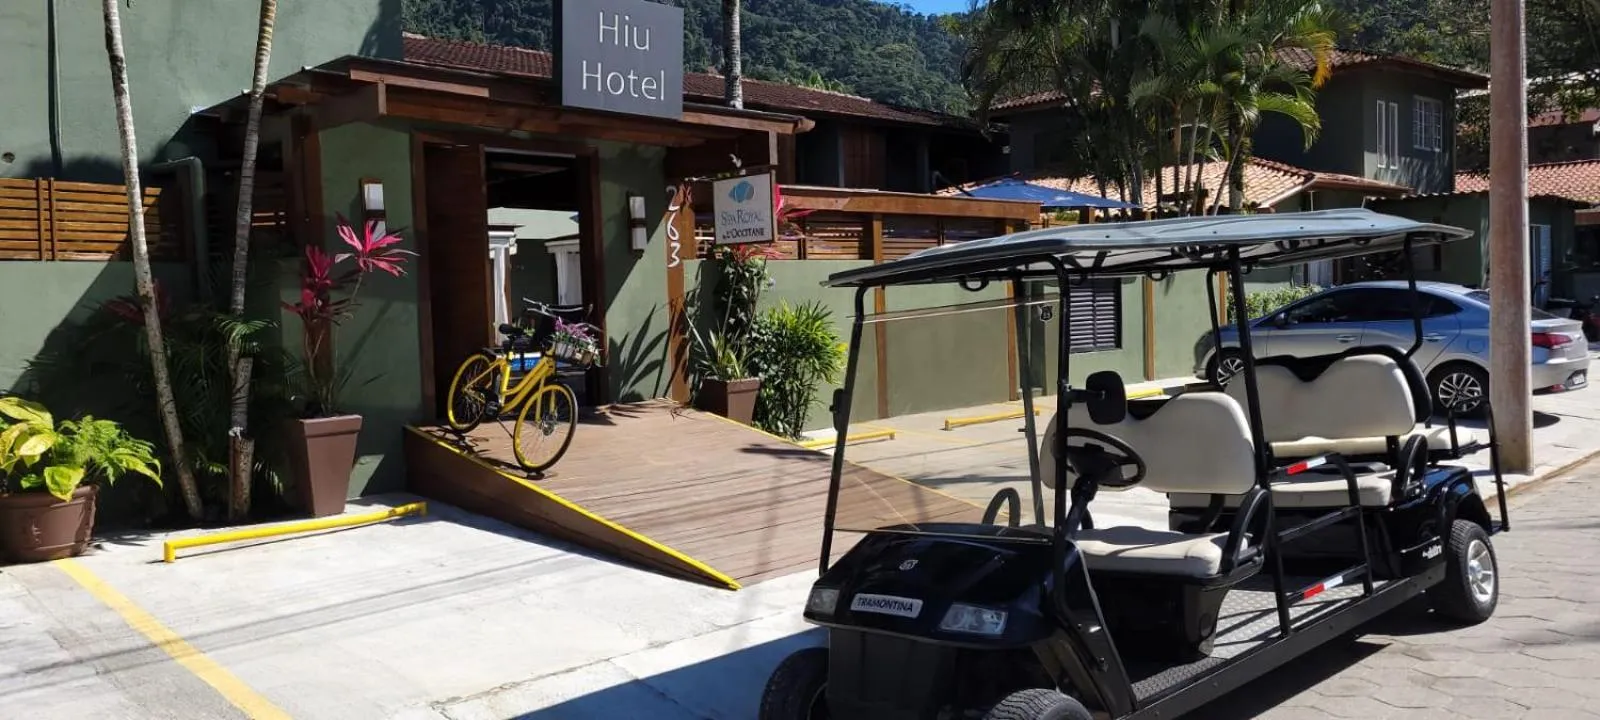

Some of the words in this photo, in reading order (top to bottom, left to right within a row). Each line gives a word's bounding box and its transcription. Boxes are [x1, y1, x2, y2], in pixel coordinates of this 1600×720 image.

[599, 11, 650, 51] Hiu
[582, 60, 665, 101] Hotel
[665, 185, 681, 268] 263
[857, 597, 914, 613] TRAMONTINA
